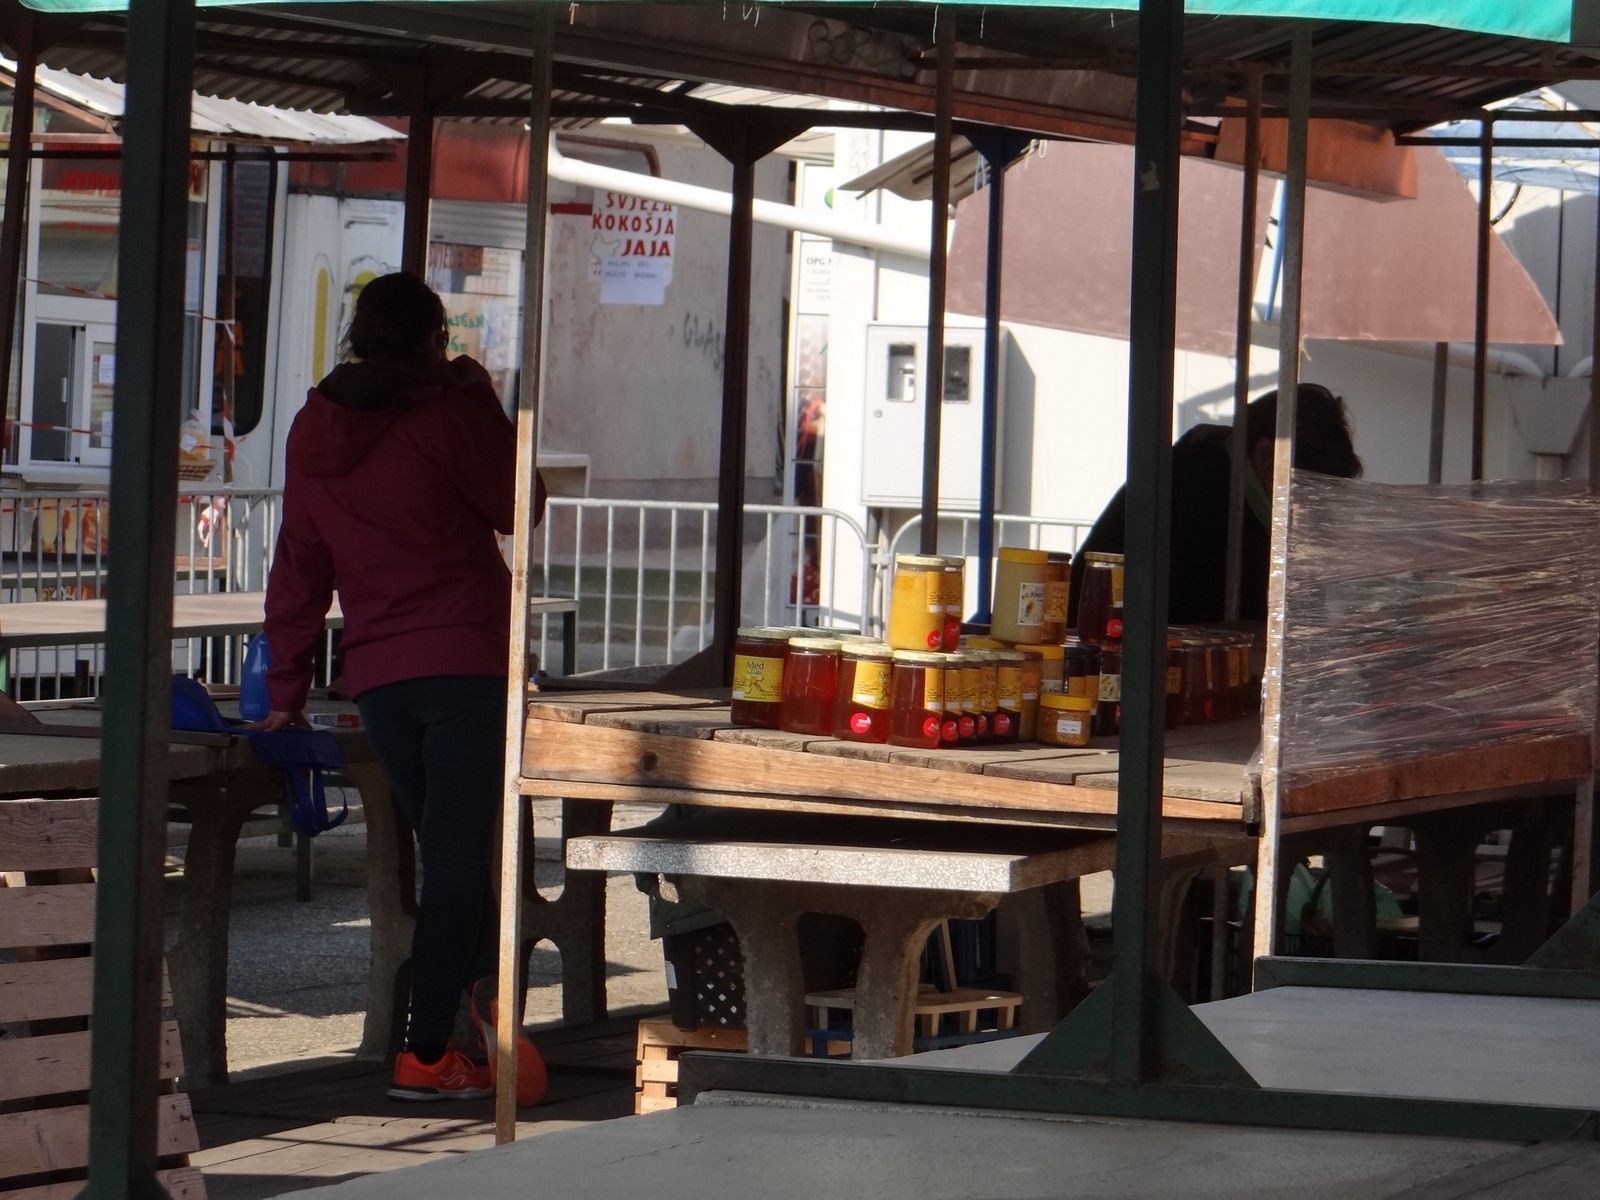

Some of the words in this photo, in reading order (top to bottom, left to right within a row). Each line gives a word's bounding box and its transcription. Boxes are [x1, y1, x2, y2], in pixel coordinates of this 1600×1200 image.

[592, 211, 674, 236] KOKOŠJA
[621, 239, 671, 256] JAJA
[806, 257, 825, 265] OPG
[746, 661, 765, 670] Med
